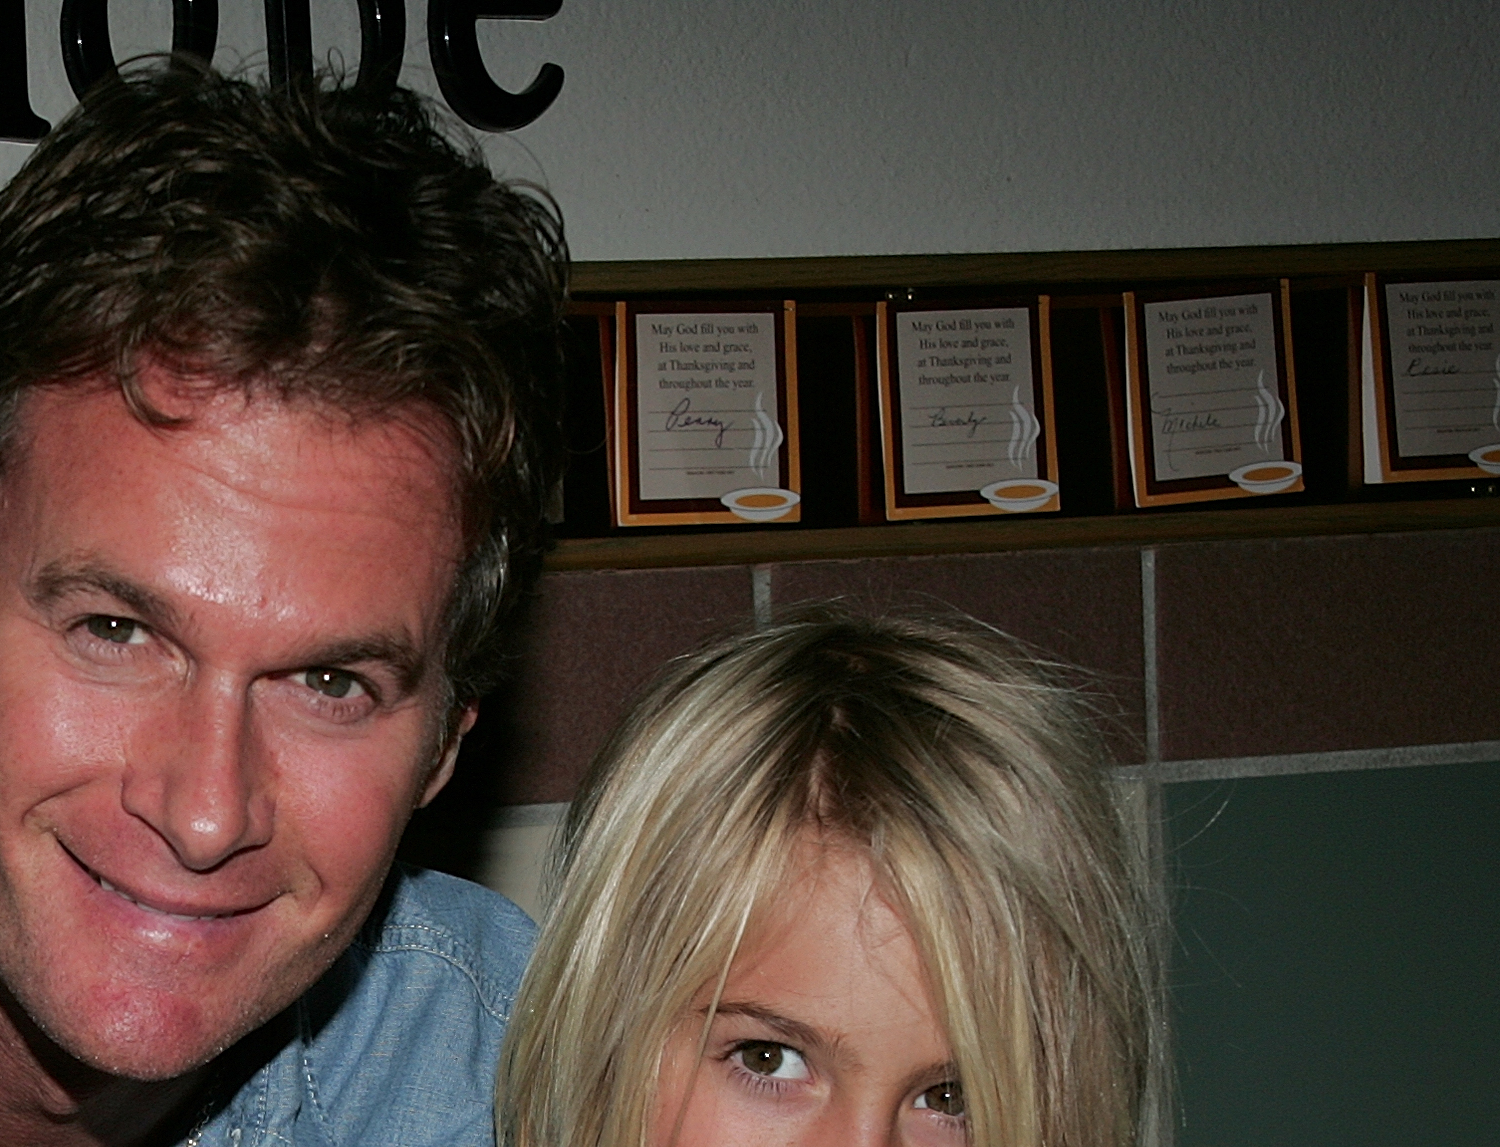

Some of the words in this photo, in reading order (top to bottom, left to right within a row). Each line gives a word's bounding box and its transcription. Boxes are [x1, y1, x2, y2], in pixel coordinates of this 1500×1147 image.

[651, 323, 673, 337] May
[676, 322, 698, 335] God
[700, 322, 714, 335] fill
[716, 325, 735, 338] you
[737, 321, 759, 334] with
[911, 321, 933, 334] May
[935, 318, 957, 332] God
[958, 318, 972, 331] fill
[973, 321, 992, 333] you
[993, 317, 1015, 329] with
[659, 341, 677, 353] His
[679, 341, 700, 353] love
[702, 340, 720, 353] and
[919, 338, 937, 350] His
[938, 337, 959, 349] love
[960, 335, 979, 349] and
[657, 361, 667, 371] at
[669, 359, 736, 374] Thanksgiving
[737, 358, 756, 371] and
[917, 358, 926, 368] at
[928, 353, 993, 369] Thanksgiving
[994, 352, 1012, 365] and
[658, 377, 712, 392] throughout
[714, 376, 730, 389] the
[918, 372, 971, 387] throughout
[972, 371, 988, 383] the
[665, 398, 733, 448] Penny
